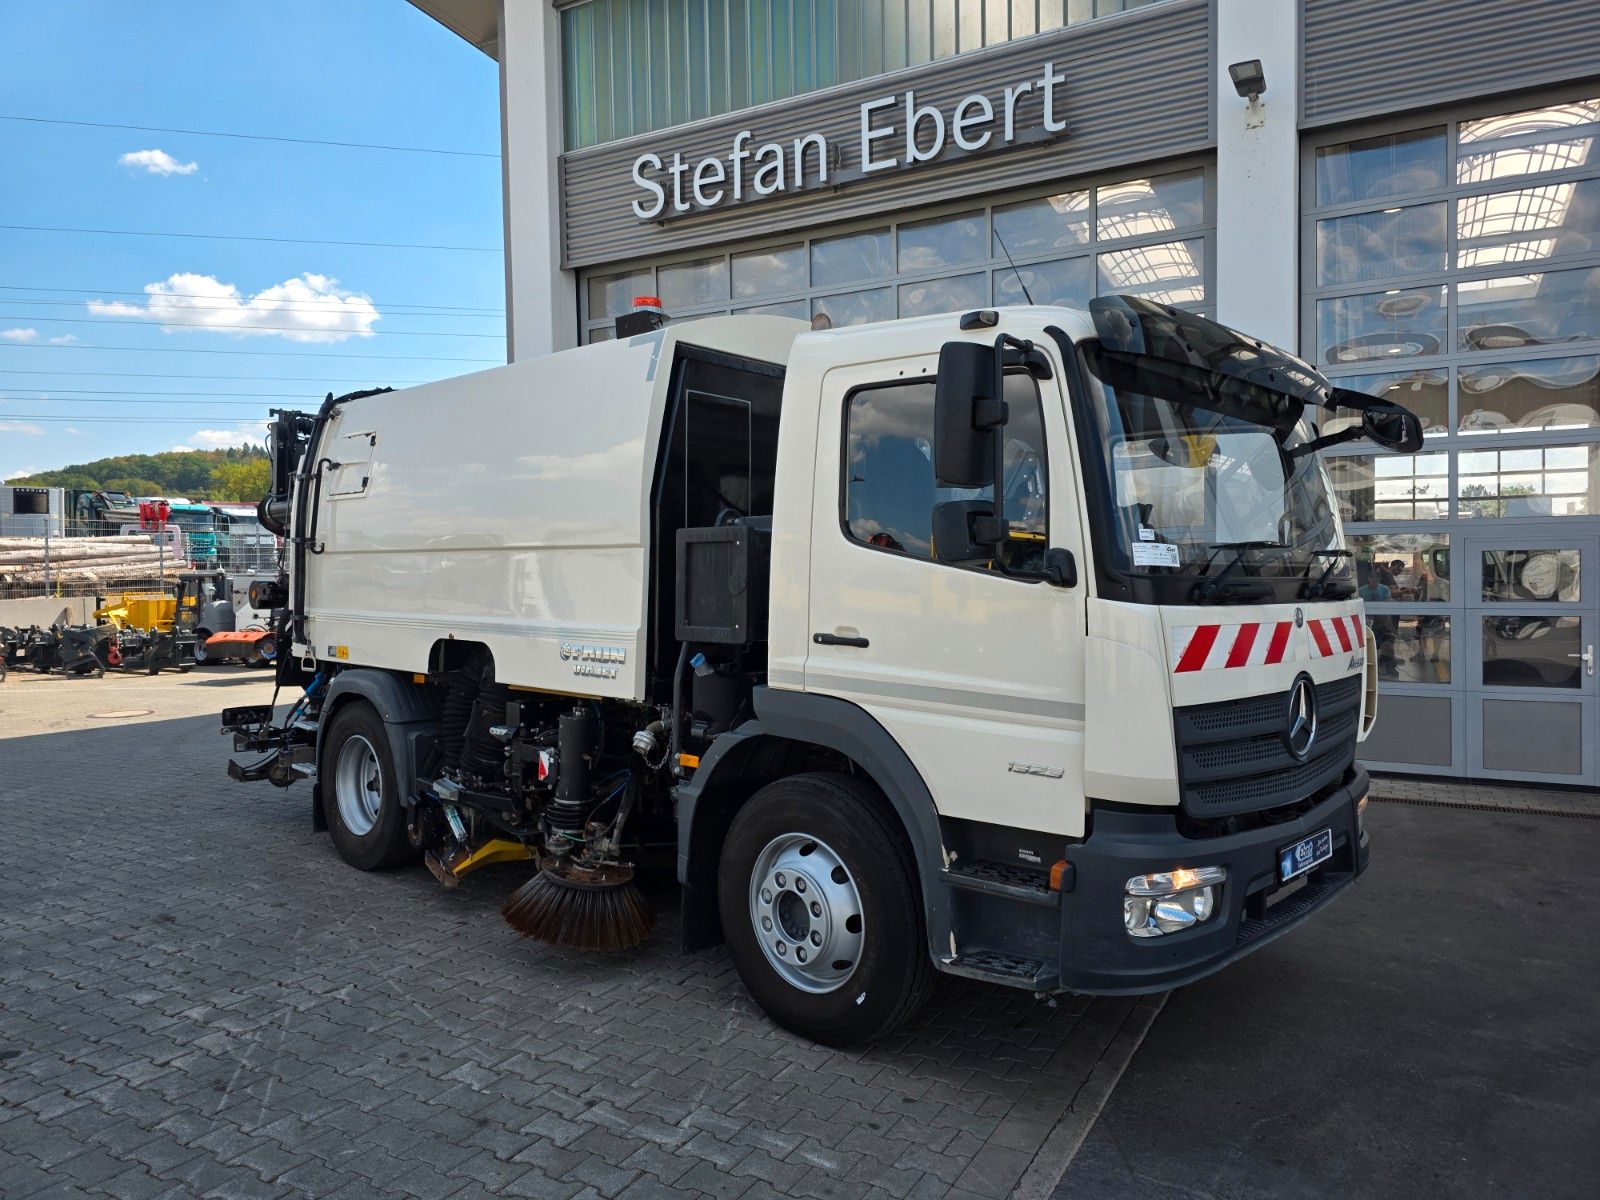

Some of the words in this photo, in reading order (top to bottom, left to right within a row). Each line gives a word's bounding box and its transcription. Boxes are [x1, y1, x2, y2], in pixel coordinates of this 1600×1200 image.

[631, 130, 828, 220] Stefan
[860, 61, 1068, 175] Ebert
[572, 643, 627, 665] FAUN
